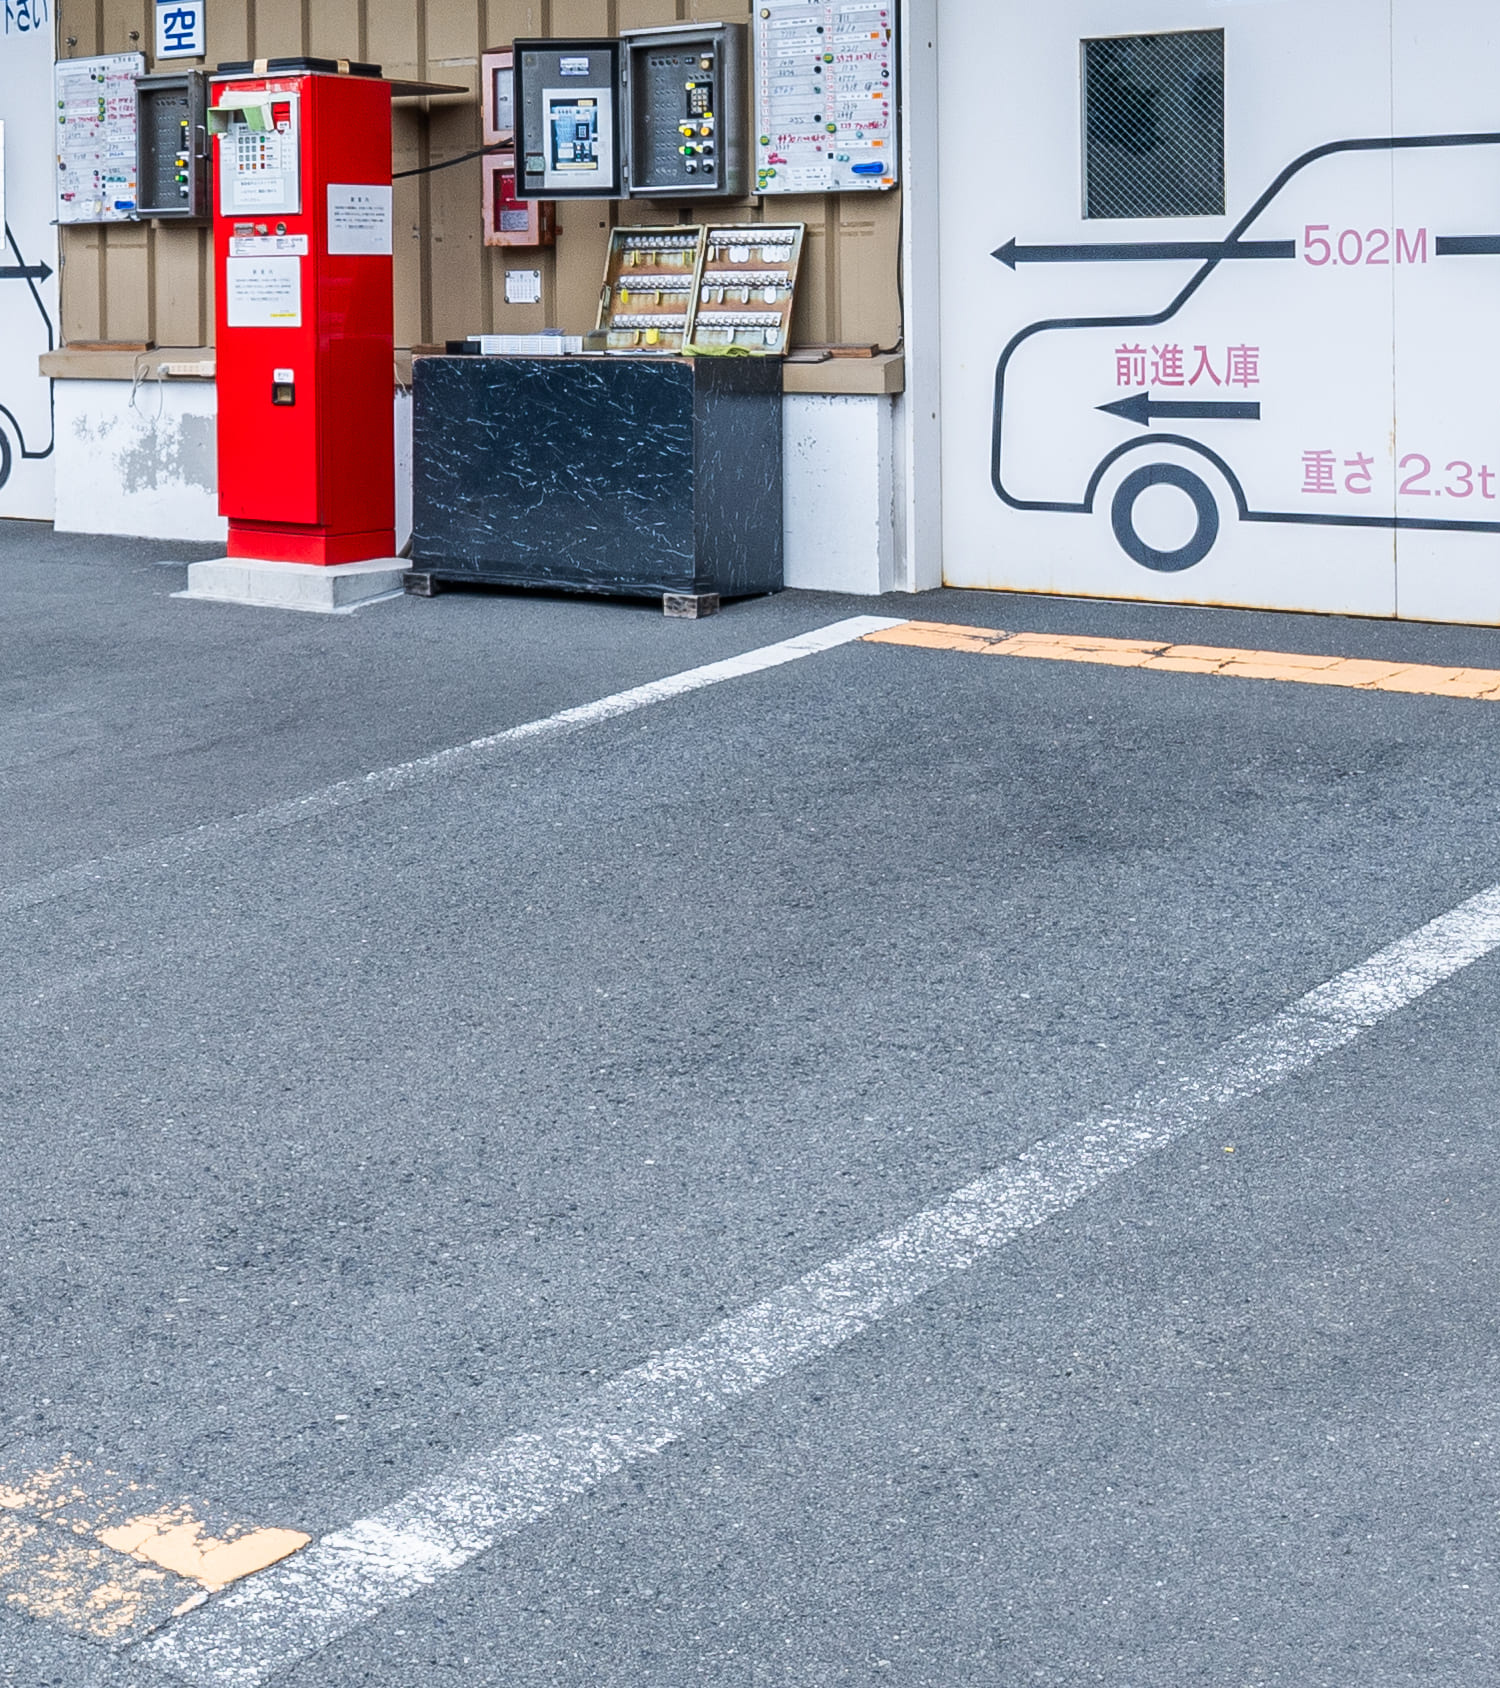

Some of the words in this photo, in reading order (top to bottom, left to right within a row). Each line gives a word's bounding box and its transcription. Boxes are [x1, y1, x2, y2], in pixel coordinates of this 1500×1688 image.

[164, 8, 196, 51] 空
[1302, 223, 1429, 266] 5.02M
[1114, 342, 1261, 389] 前進入庫
[1301, 449, 1374, 494] 重さ
[1398, 452, 1496, 499] 2.3t
